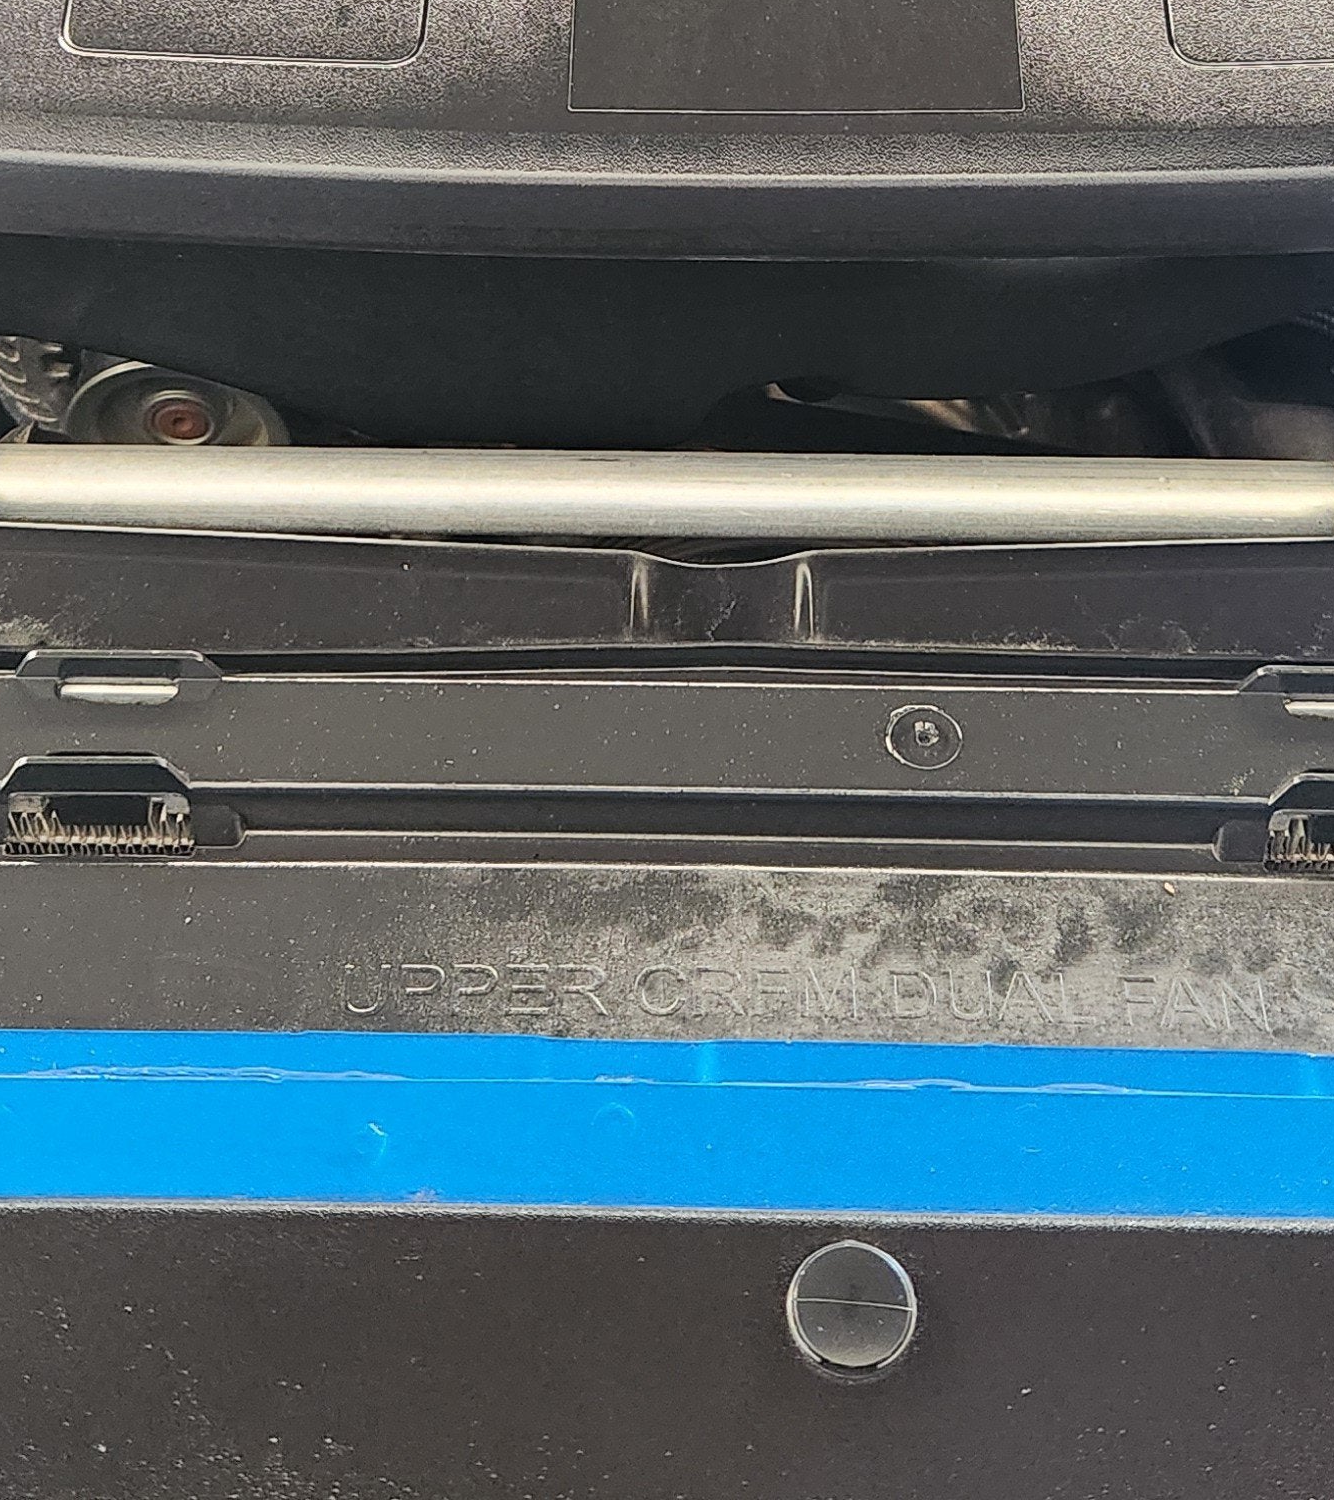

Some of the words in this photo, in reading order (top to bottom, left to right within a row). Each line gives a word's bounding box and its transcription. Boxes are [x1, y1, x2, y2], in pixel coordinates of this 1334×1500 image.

[342, 962, 610, 1018] UPPER
[633, 963, 859, 1020] CRFM
[888, 969, 1098, 1026] DUAL
[1118, 976, 1275, 1033] FAN
